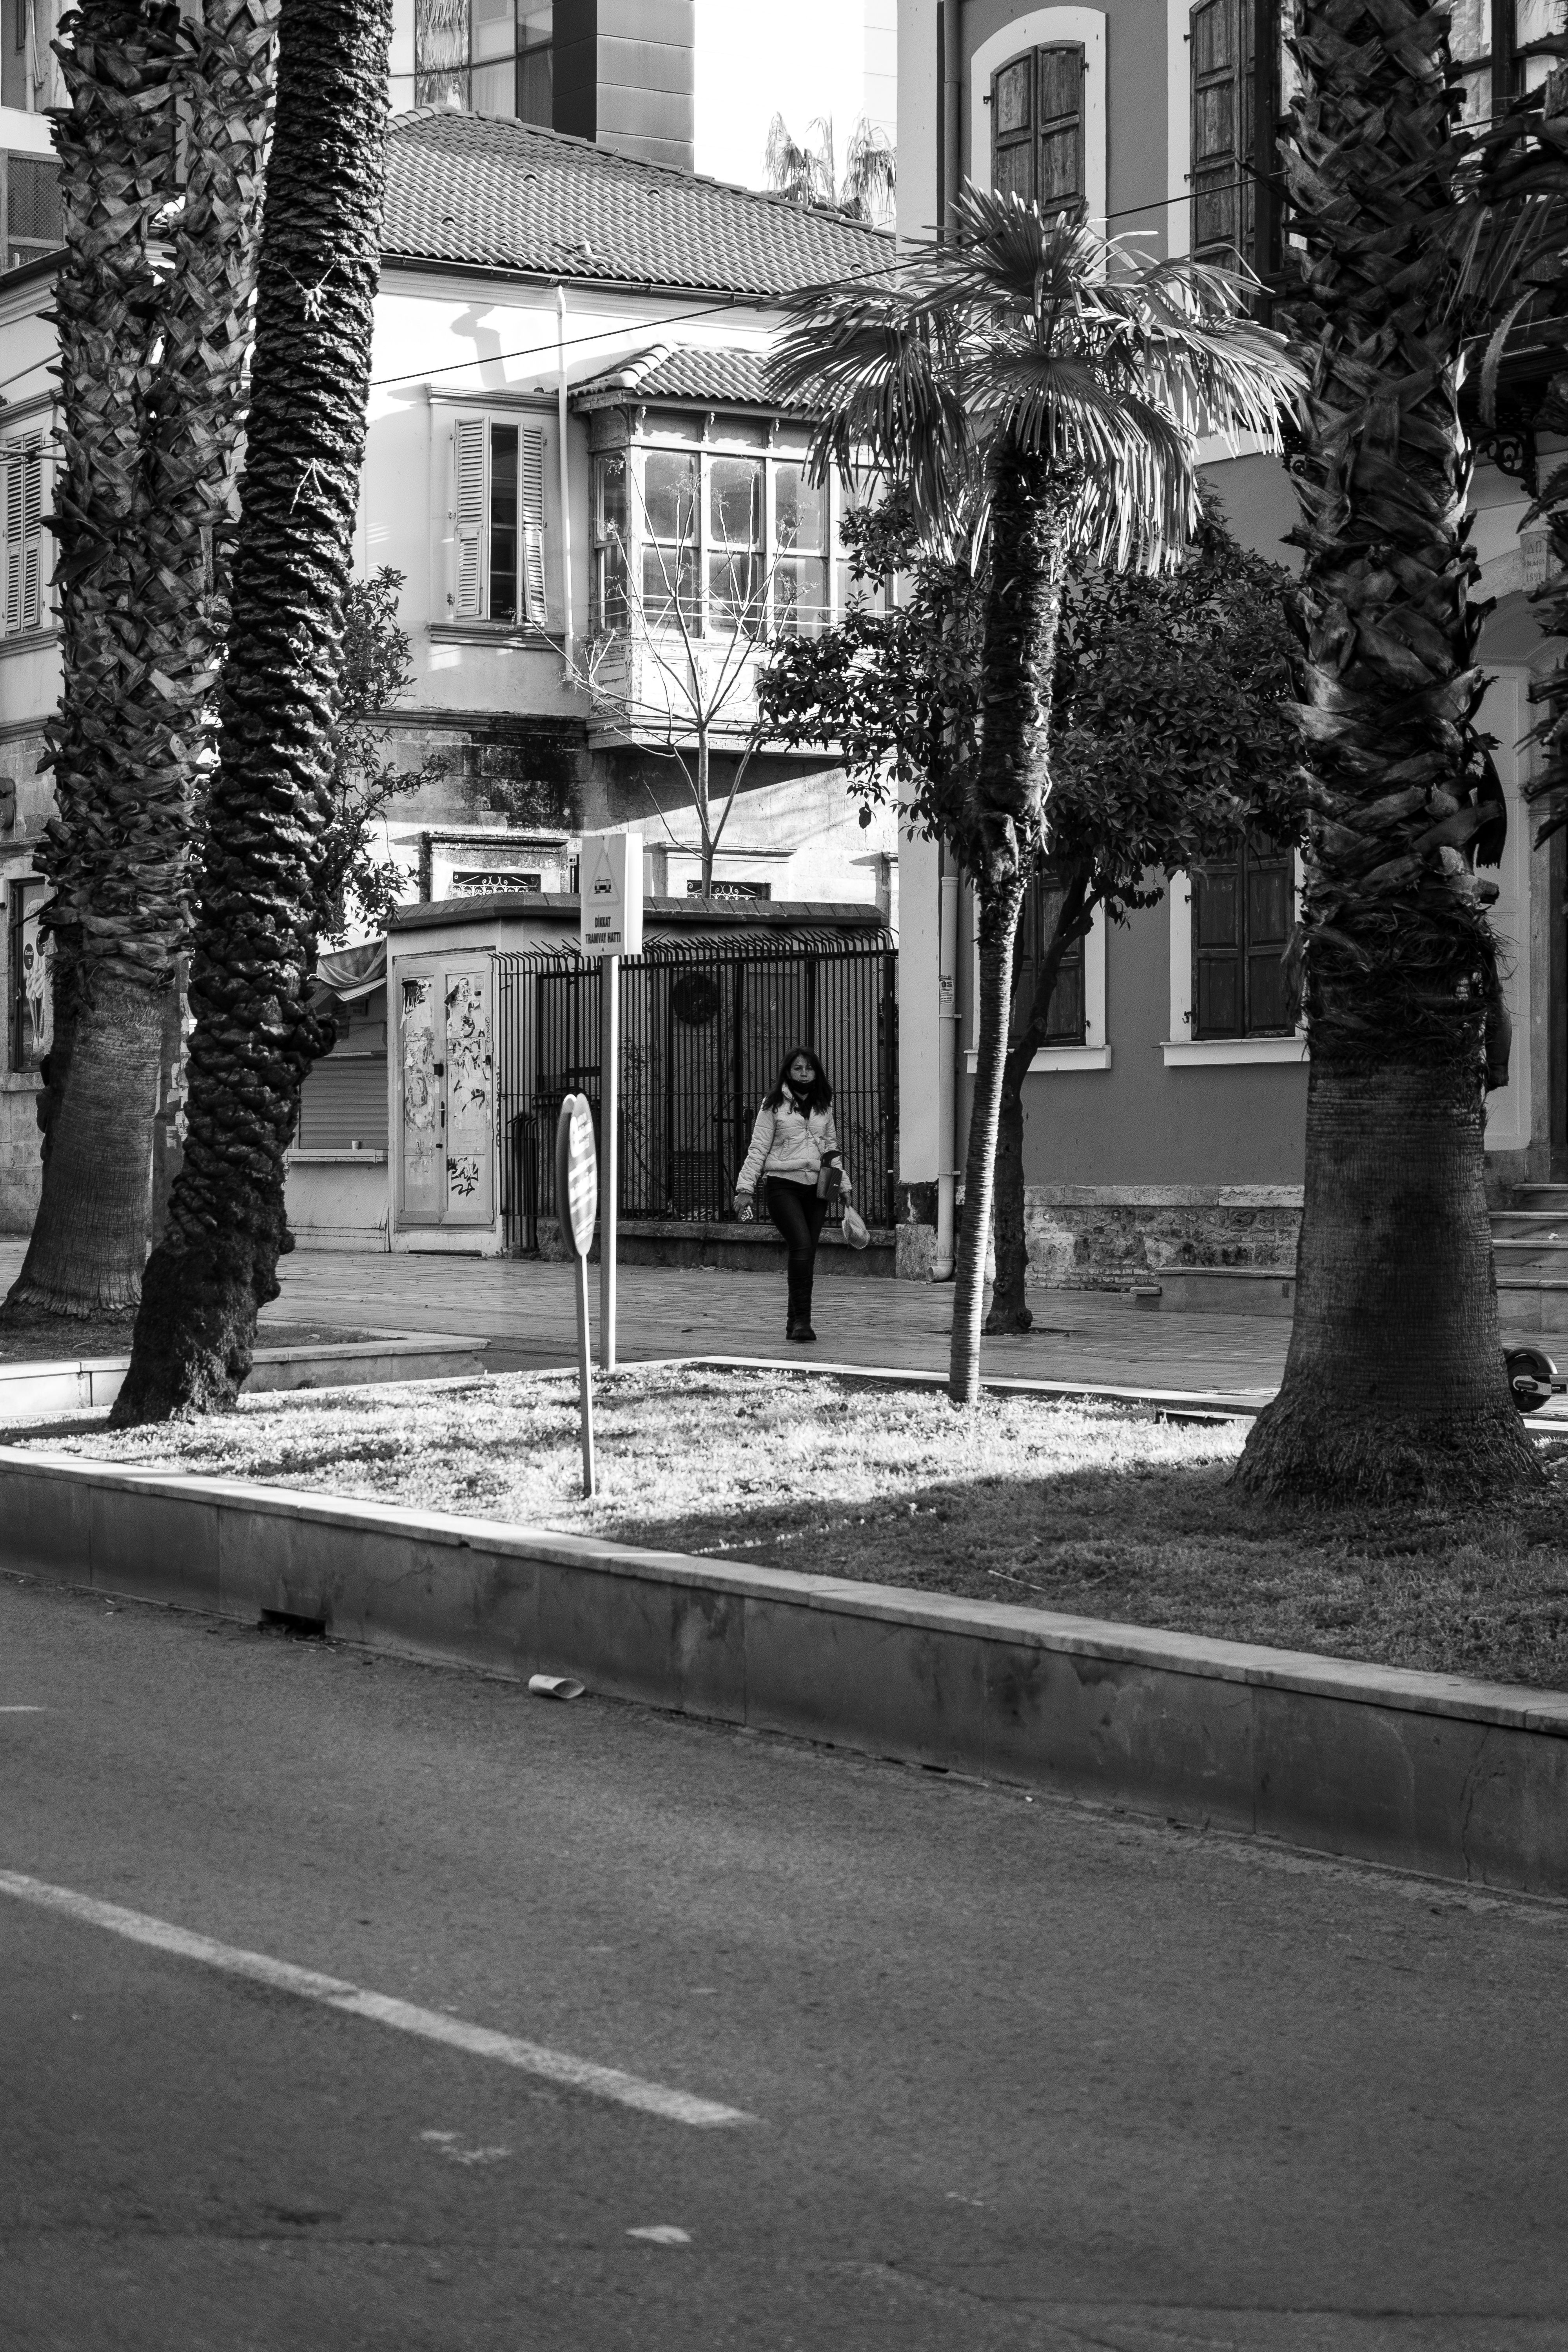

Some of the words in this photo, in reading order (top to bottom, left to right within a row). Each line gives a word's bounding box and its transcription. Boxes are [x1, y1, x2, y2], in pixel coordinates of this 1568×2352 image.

[595, 915, 611, 927] DİKKAT
[586, 933, 606, 944] TRAMVAY
[607, 932, 621, 943] HATTI
